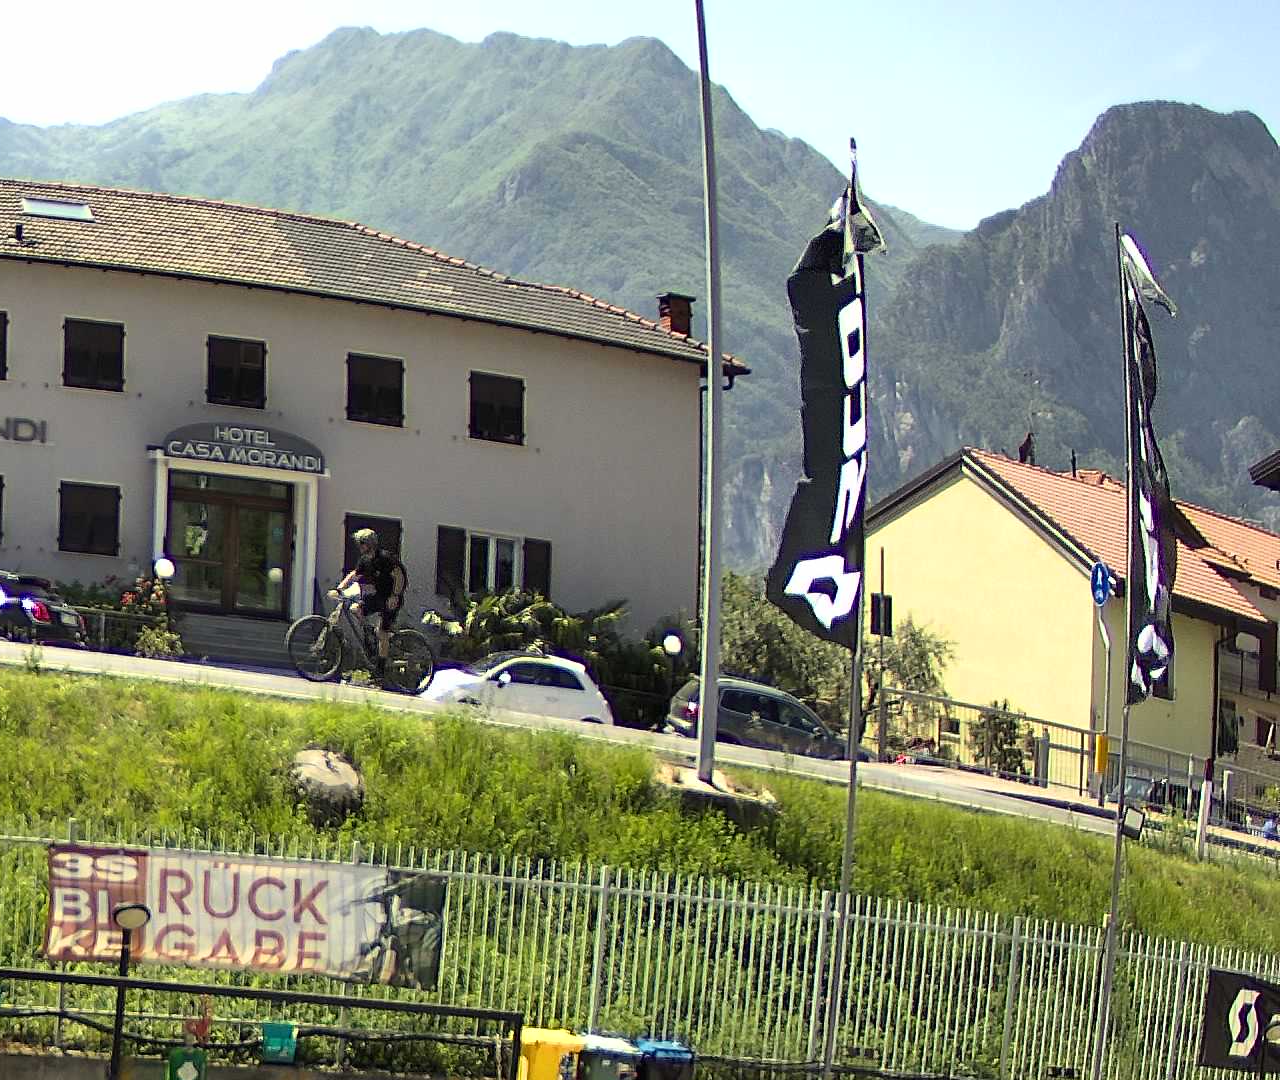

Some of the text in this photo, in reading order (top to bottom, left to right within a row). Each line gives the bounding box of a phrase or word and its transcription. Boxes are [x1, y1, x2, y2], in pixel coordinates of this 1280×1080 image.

[214, 425, 276, 446] HOTEL
[168, 441, 321, 472] CASA MORANDI
[51, 853, 138, 883] 3S
[158, 862, 330, 925] RÜCK
[154, 924, 327, 971] GABE
